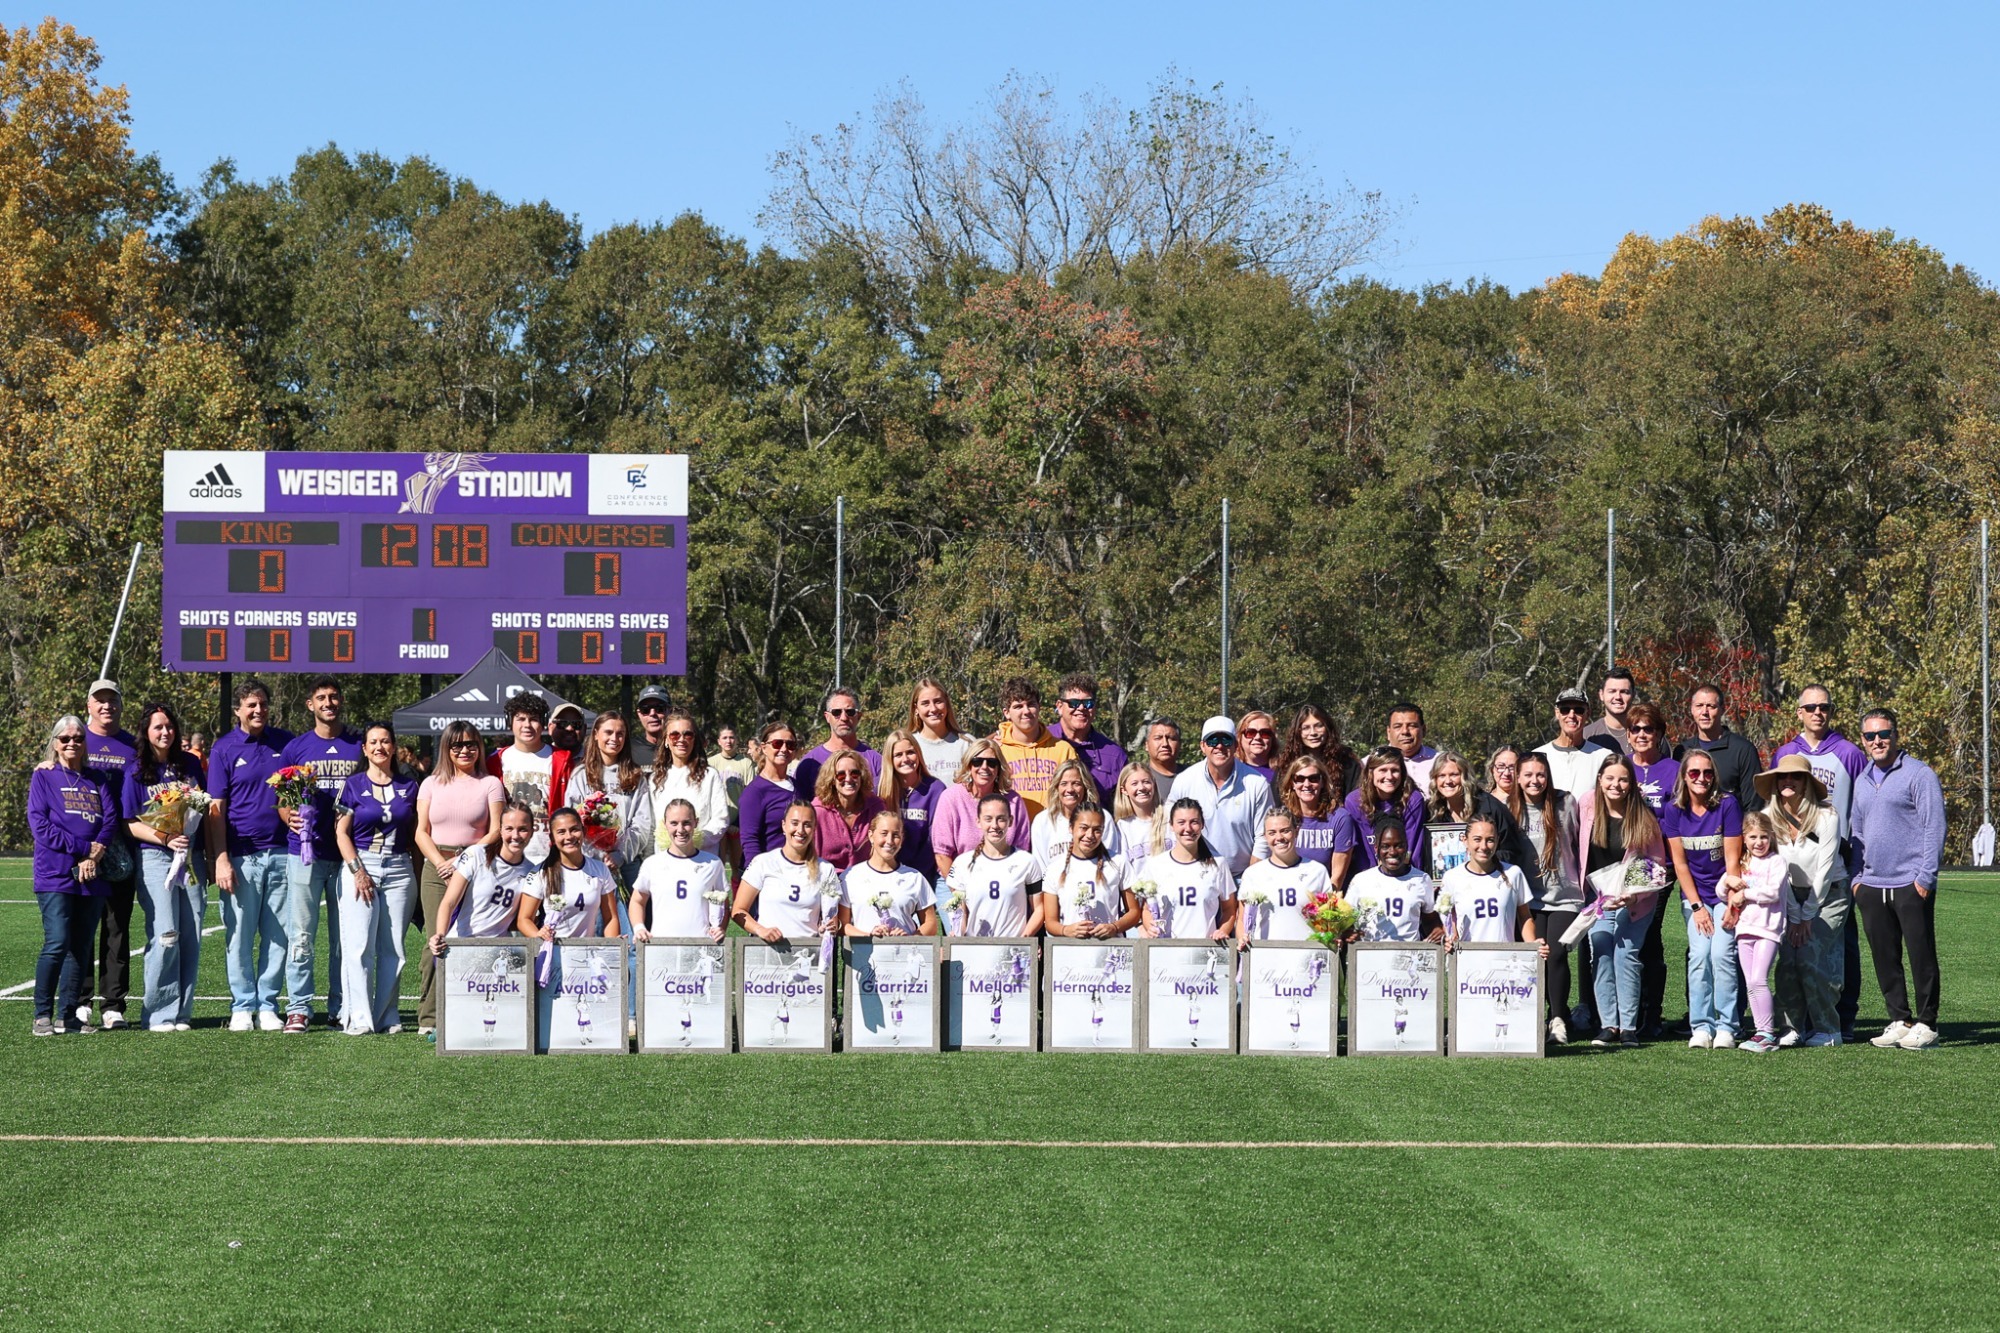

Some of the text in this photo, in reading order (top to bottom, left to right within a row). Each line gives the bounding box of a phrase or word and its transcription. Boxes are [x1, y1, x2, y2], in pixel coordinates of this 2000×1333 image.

[189, 486, 242, 498] adidas
[277, 469, 572, 498] WEISIGER STADIUM
[220, 522, 293, 544] KING
[517, 523, 667, 547] CONVERSE
[381, 524, 488, 567] 12 08
[259, 550, 284, 592] 0
[594, 552, 620, 596] 0
[179, 609, 357, 627] SHOTS CORNERS SAVES
[491, 612, 669, 629] SHOTS CORNERS SAVES
[206, 628, 226, 660] 0
[270, 629, 289, 661] 0
[333, 630, 353, 661] 0
[400, 644, 449, 658] PERIOD
[518, 631, 538, 663] 0
[582, 632, 601, 663] 0
[645, 632, 665, 664] 0
[1812, 767, 1836, 788] ERSE
[381, 804, 392, 823] 3
[1296, 828, 1334, 849] NVERSE
[490, 885, 514, 908] 28
[676, 880, 687, 899] 6
[789, 884, 801, 902] 3
[989, 880, 1000, 900] 8
[1178, 886, 1197, 906] 12
[1278, 887, 1297, 907] 18
[574, 893, 585, 911] 4
[1385, 897, 1404, 917] 19
[1474, 897, 1499, 919] 26
[467, 980, 520, 993] Parsick
[554, 981, 607, 995] Avalos
[664, 981, 705, 995] Cash
[744, 981, 824, 998] Rodrigues
[861, 980, 928, 994] Giarrizzi
[969, 980, 1023, 993] Mellon
[1053, 980, 1132, 993] Hernandez
[1174, 982, 1219, 995] Novik
[1275, 984, 1313, 997] Lund
[1382, 985, 1429, 1001] Henry
[1460, 982, 1532, 999] Pumphrey
